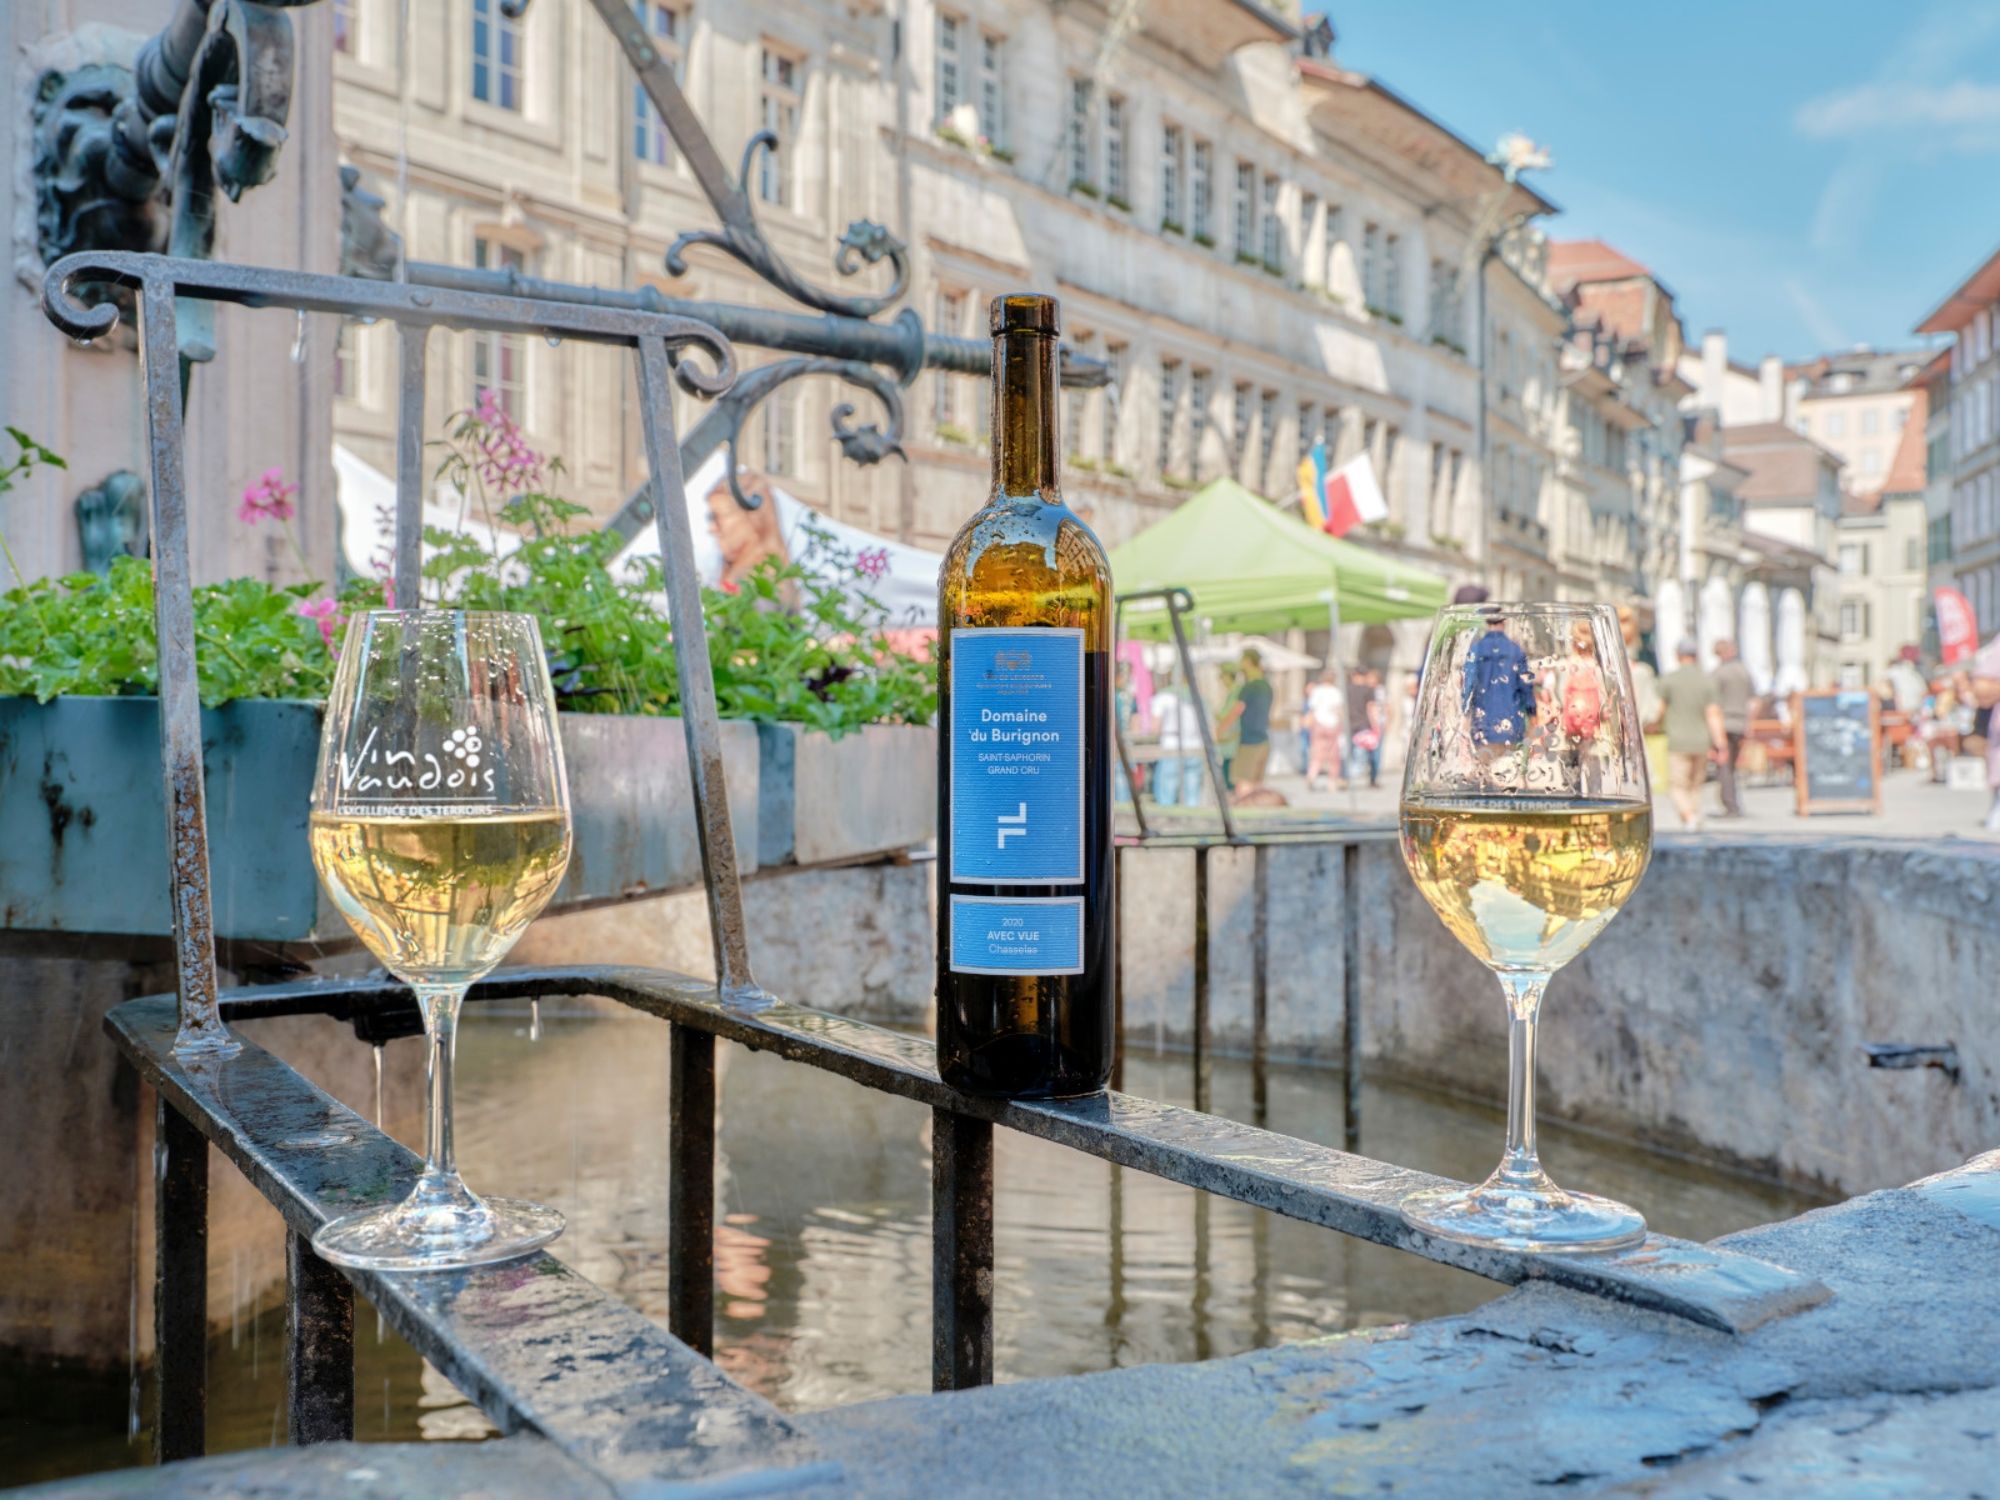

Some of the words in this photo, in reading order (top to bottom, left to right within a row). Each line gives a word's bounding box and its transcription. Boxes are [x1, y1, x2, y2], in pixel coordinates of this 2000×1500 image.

[981, 708, 1048, 722] Domaine
[970, 728, 988, 742] du
[991, 728, 1060, 746] Burignon
[340, 726, 495, 792] Vaudois
[987, 765, 1019, 775] GRAND
[1020, 765, 1040, 775] CRU
[409, 804, 433, 816] DES
[435, 803, 492, 816] TERROIRS
[1001, 917, 1024, 927] 2020
[987, 930, 1015, 941] AVEC
[1018, 930, 1040, 941] VUE
